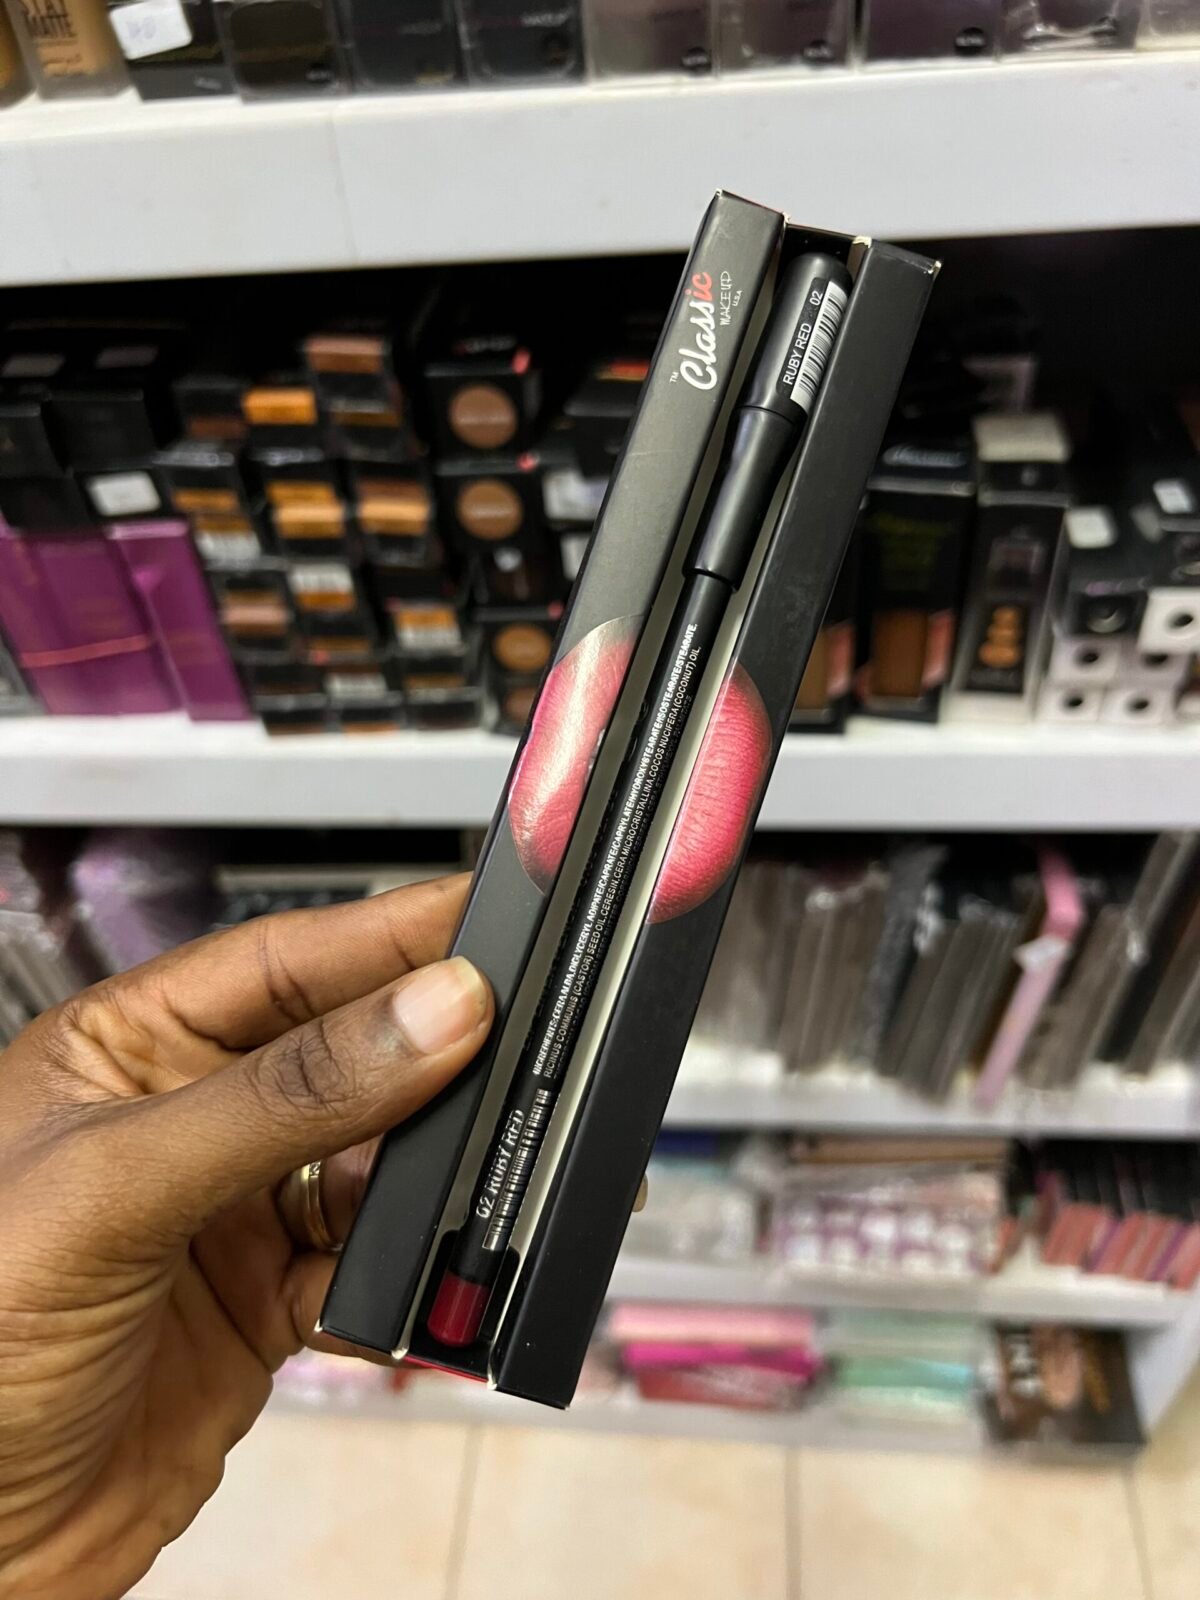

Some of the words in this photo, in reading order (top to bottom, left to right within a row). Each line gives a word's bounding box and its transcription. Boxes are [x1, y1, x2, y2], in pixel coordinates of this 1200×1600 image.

[669, 371, 679, 383] TM
[678, 271, 718, 390] Classic
[782, 349, 803, 386] RUBY
[794, 322, 812, 350] RED
[809, 290, 823, 306] 02
[542, 1040, 562, 1078] RICINUS
[554, 994, 578, 1043] COMMUNIS
[571, 953, 594, 996] (CASTOR)
[585, 929, 601, 955] SEED
[657, 705, 680, 749] NUCIFERA
[672, 660, 697, 708] (COCONUT)
